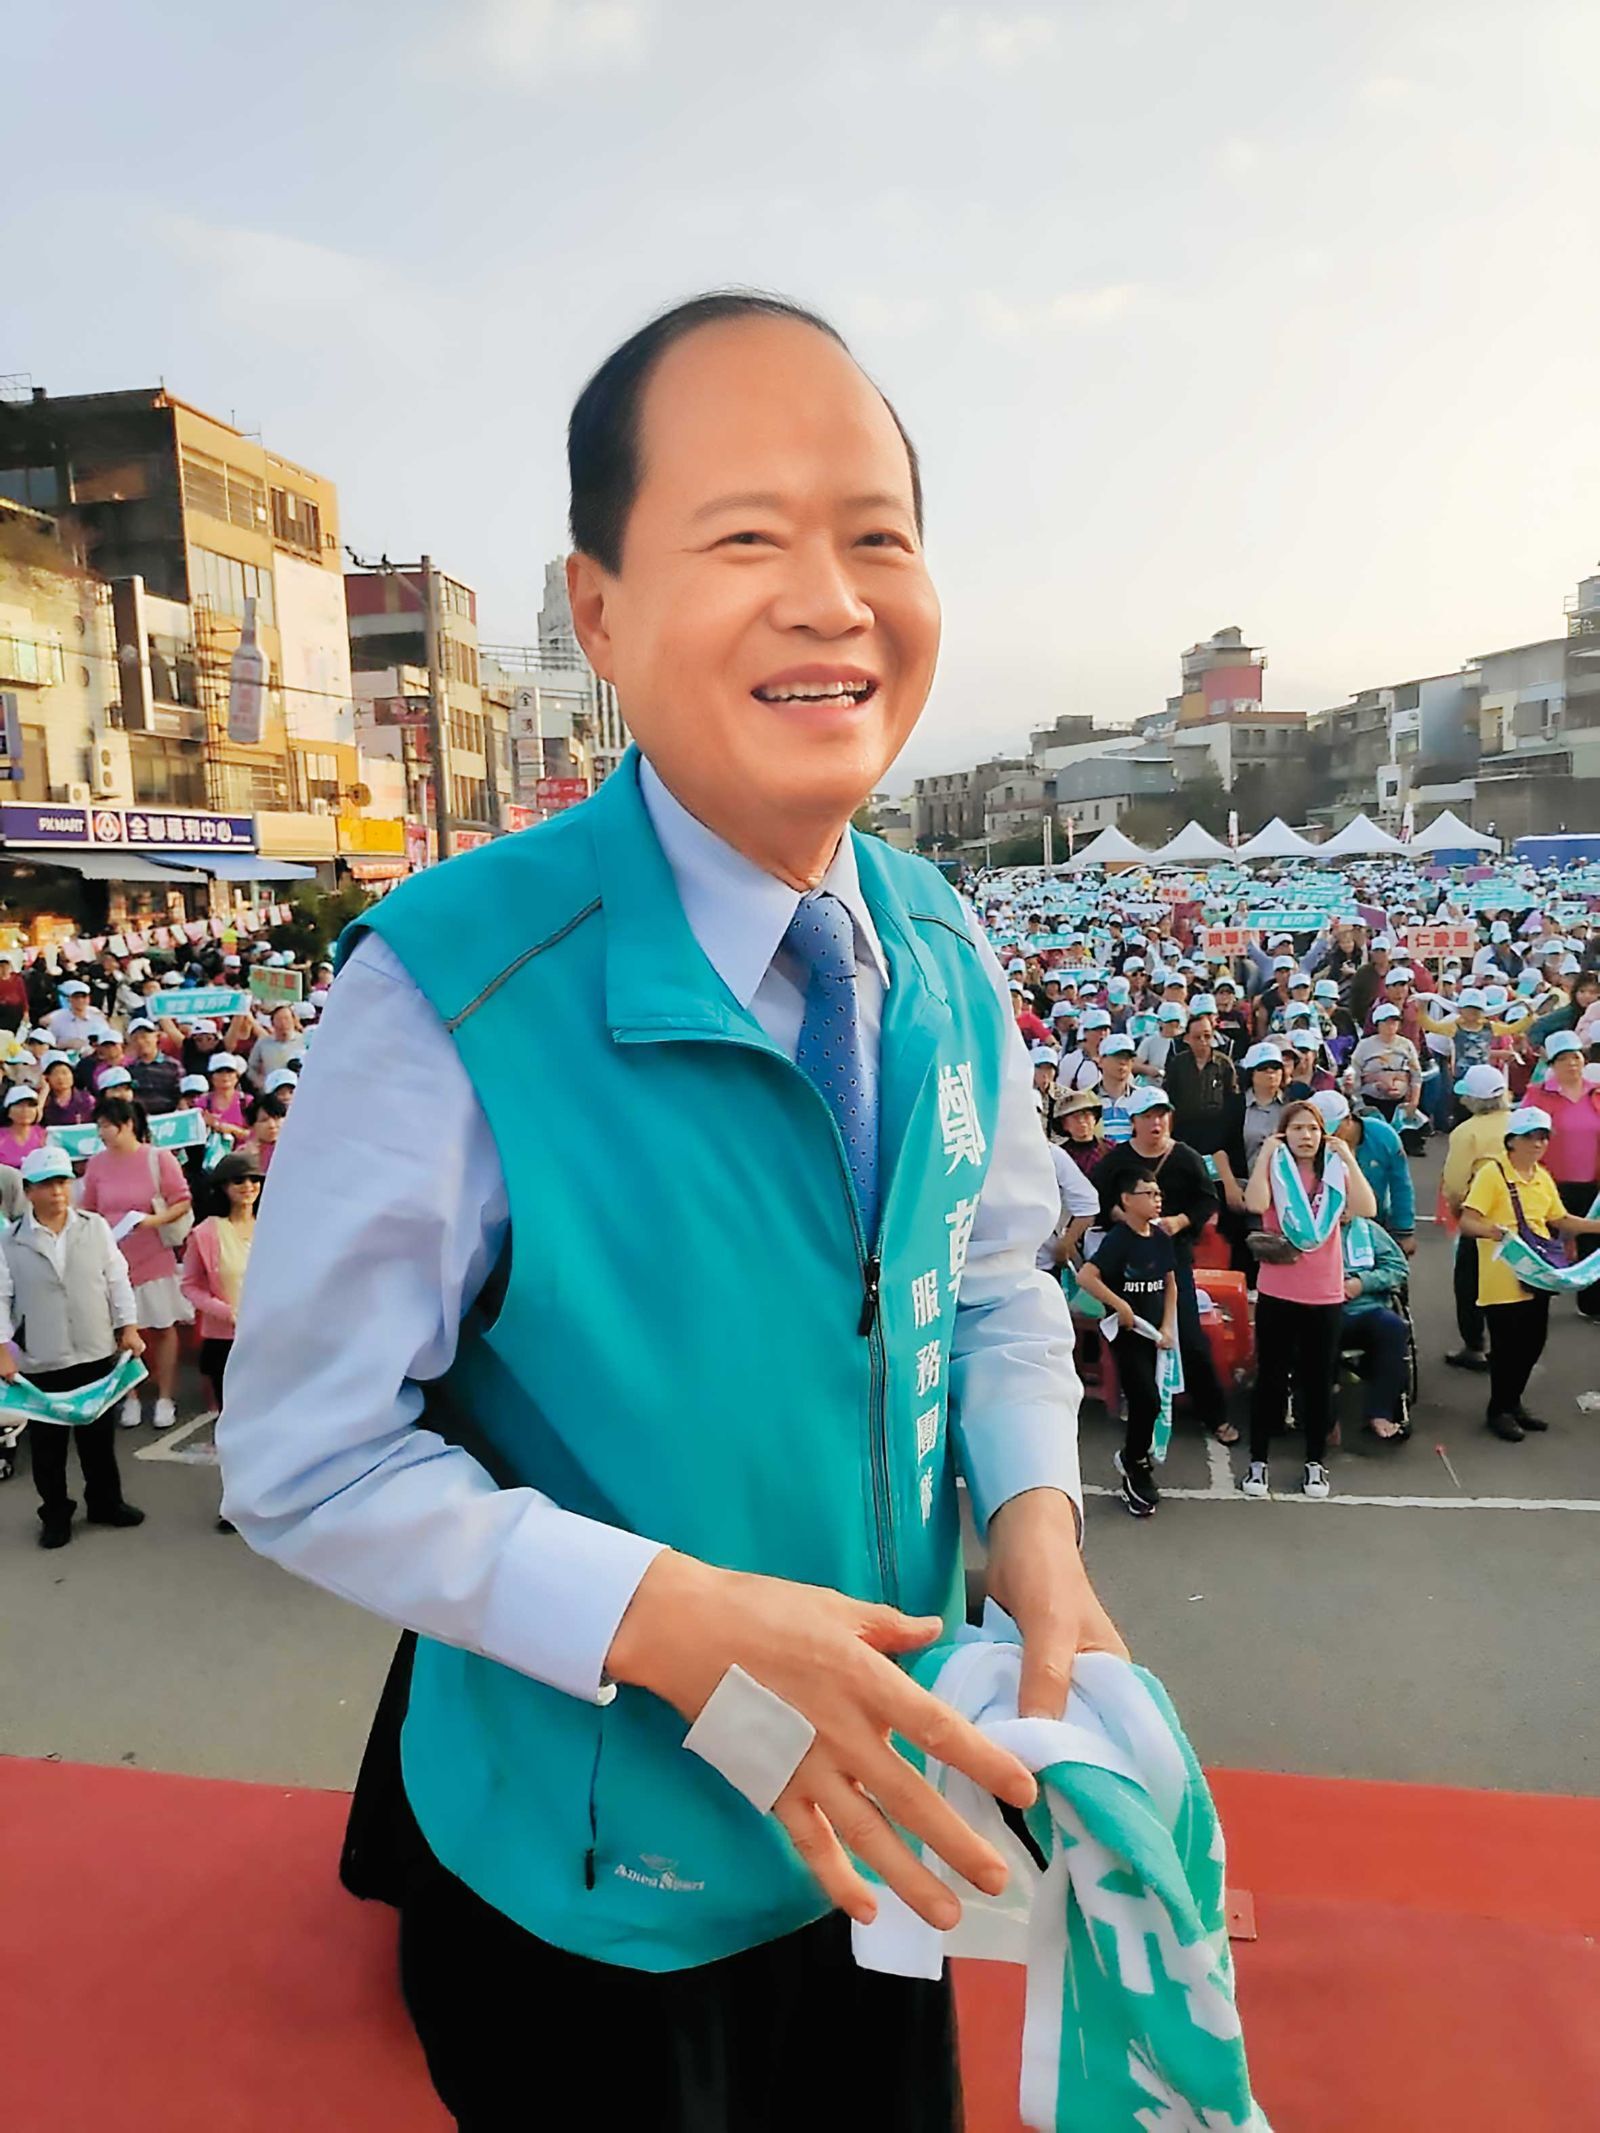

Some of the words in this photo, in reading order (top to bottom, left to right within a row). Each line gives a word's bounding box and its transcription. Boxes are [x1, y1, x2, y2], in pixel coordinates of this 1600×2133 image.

[1123, 1281, 1146, 1293] JUST
[912, 1268, 942, 1528] 服務團隊
